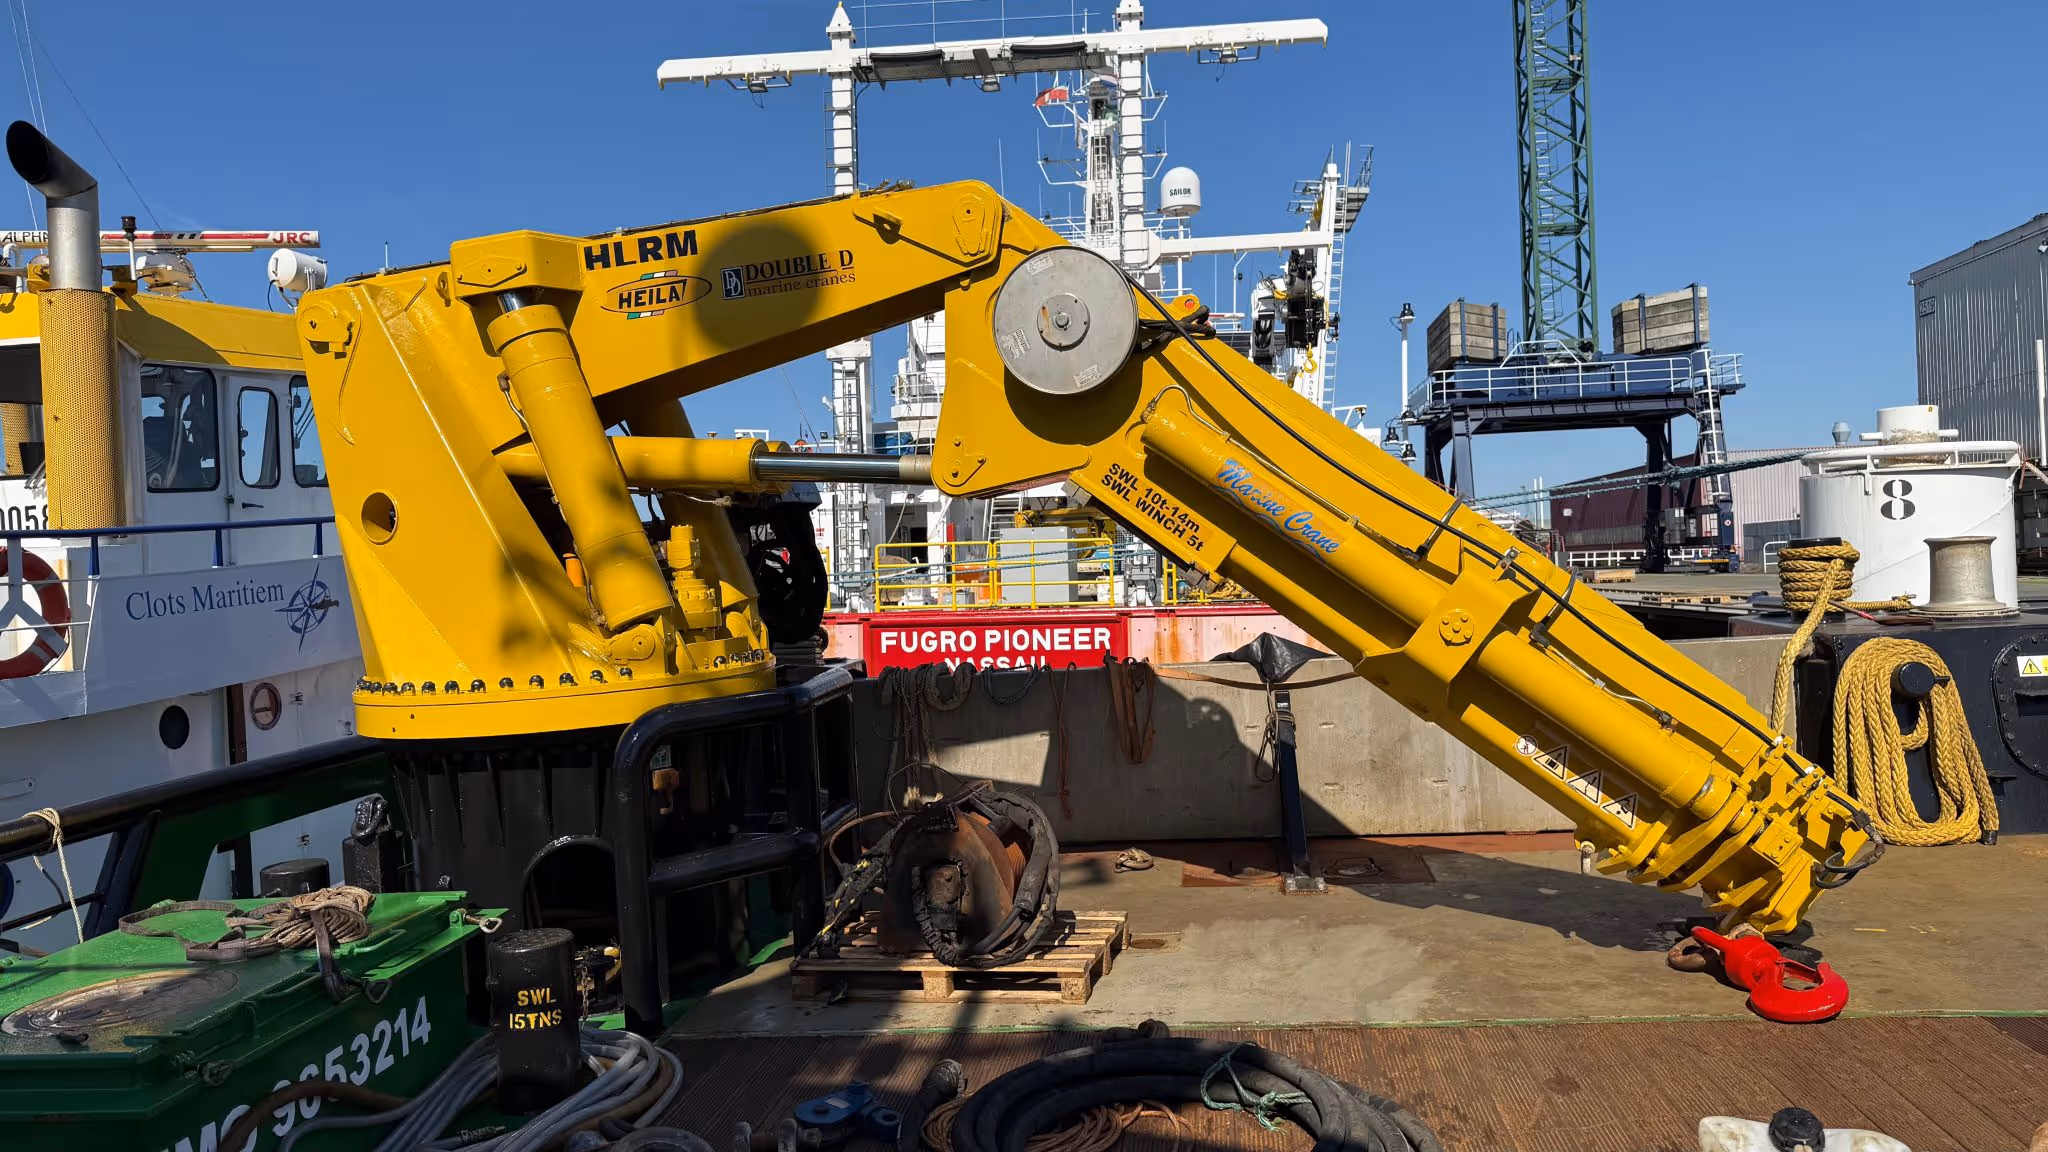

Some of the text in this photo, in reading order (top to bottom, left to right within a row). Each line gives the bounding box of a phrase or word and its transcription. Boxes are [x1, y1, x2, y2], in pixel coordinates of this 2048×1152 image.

[1169, 187, 1191, 196] SAILOR
[272, 232, 311, 244] JRC
[583, 229, 698, 271] HLRM
[744, 249, 854, 281] DOUBLE D
[618, 285, 681, 310] HEILA
[744, 272, 856, 297] marine cranes
[1101, 474, 1204, 552] SWL WINCH 5t
[1109, 463, 1201, 534] SWL 10t-14m
[1218, 458, 1340, 554] Marine Crane
[1880, 479, 1916, 520] 8
[125, 579, 285, 621] Clots Maritiem
[880, 627, 1111, 654] FUGRO PIONEER
[517, 987, 557, 1007] SWL
